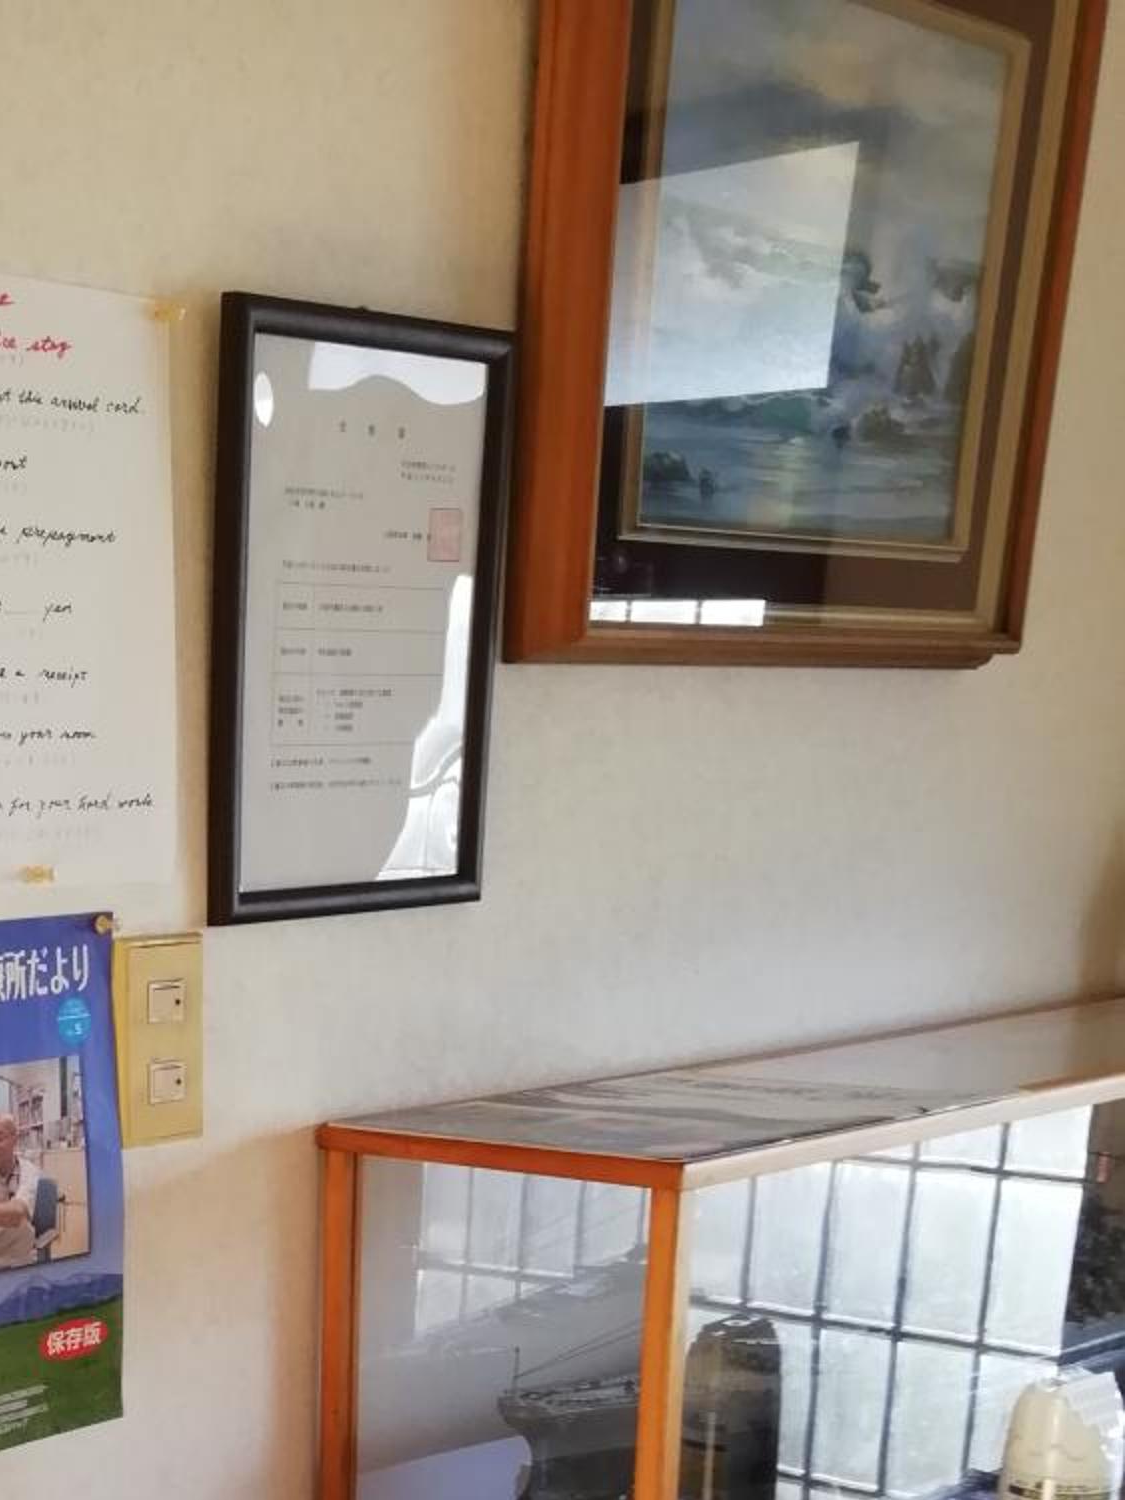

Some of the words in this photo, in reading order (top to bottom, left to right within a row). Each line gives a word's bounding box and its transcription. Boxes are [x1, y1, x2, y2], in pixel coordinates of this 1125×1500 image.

[43, 603, 72, 623] yen
[18, 728, 52, 746] your
[8, 797, 30, 816] for
[46, 1321, 102, 1355] 保存版
